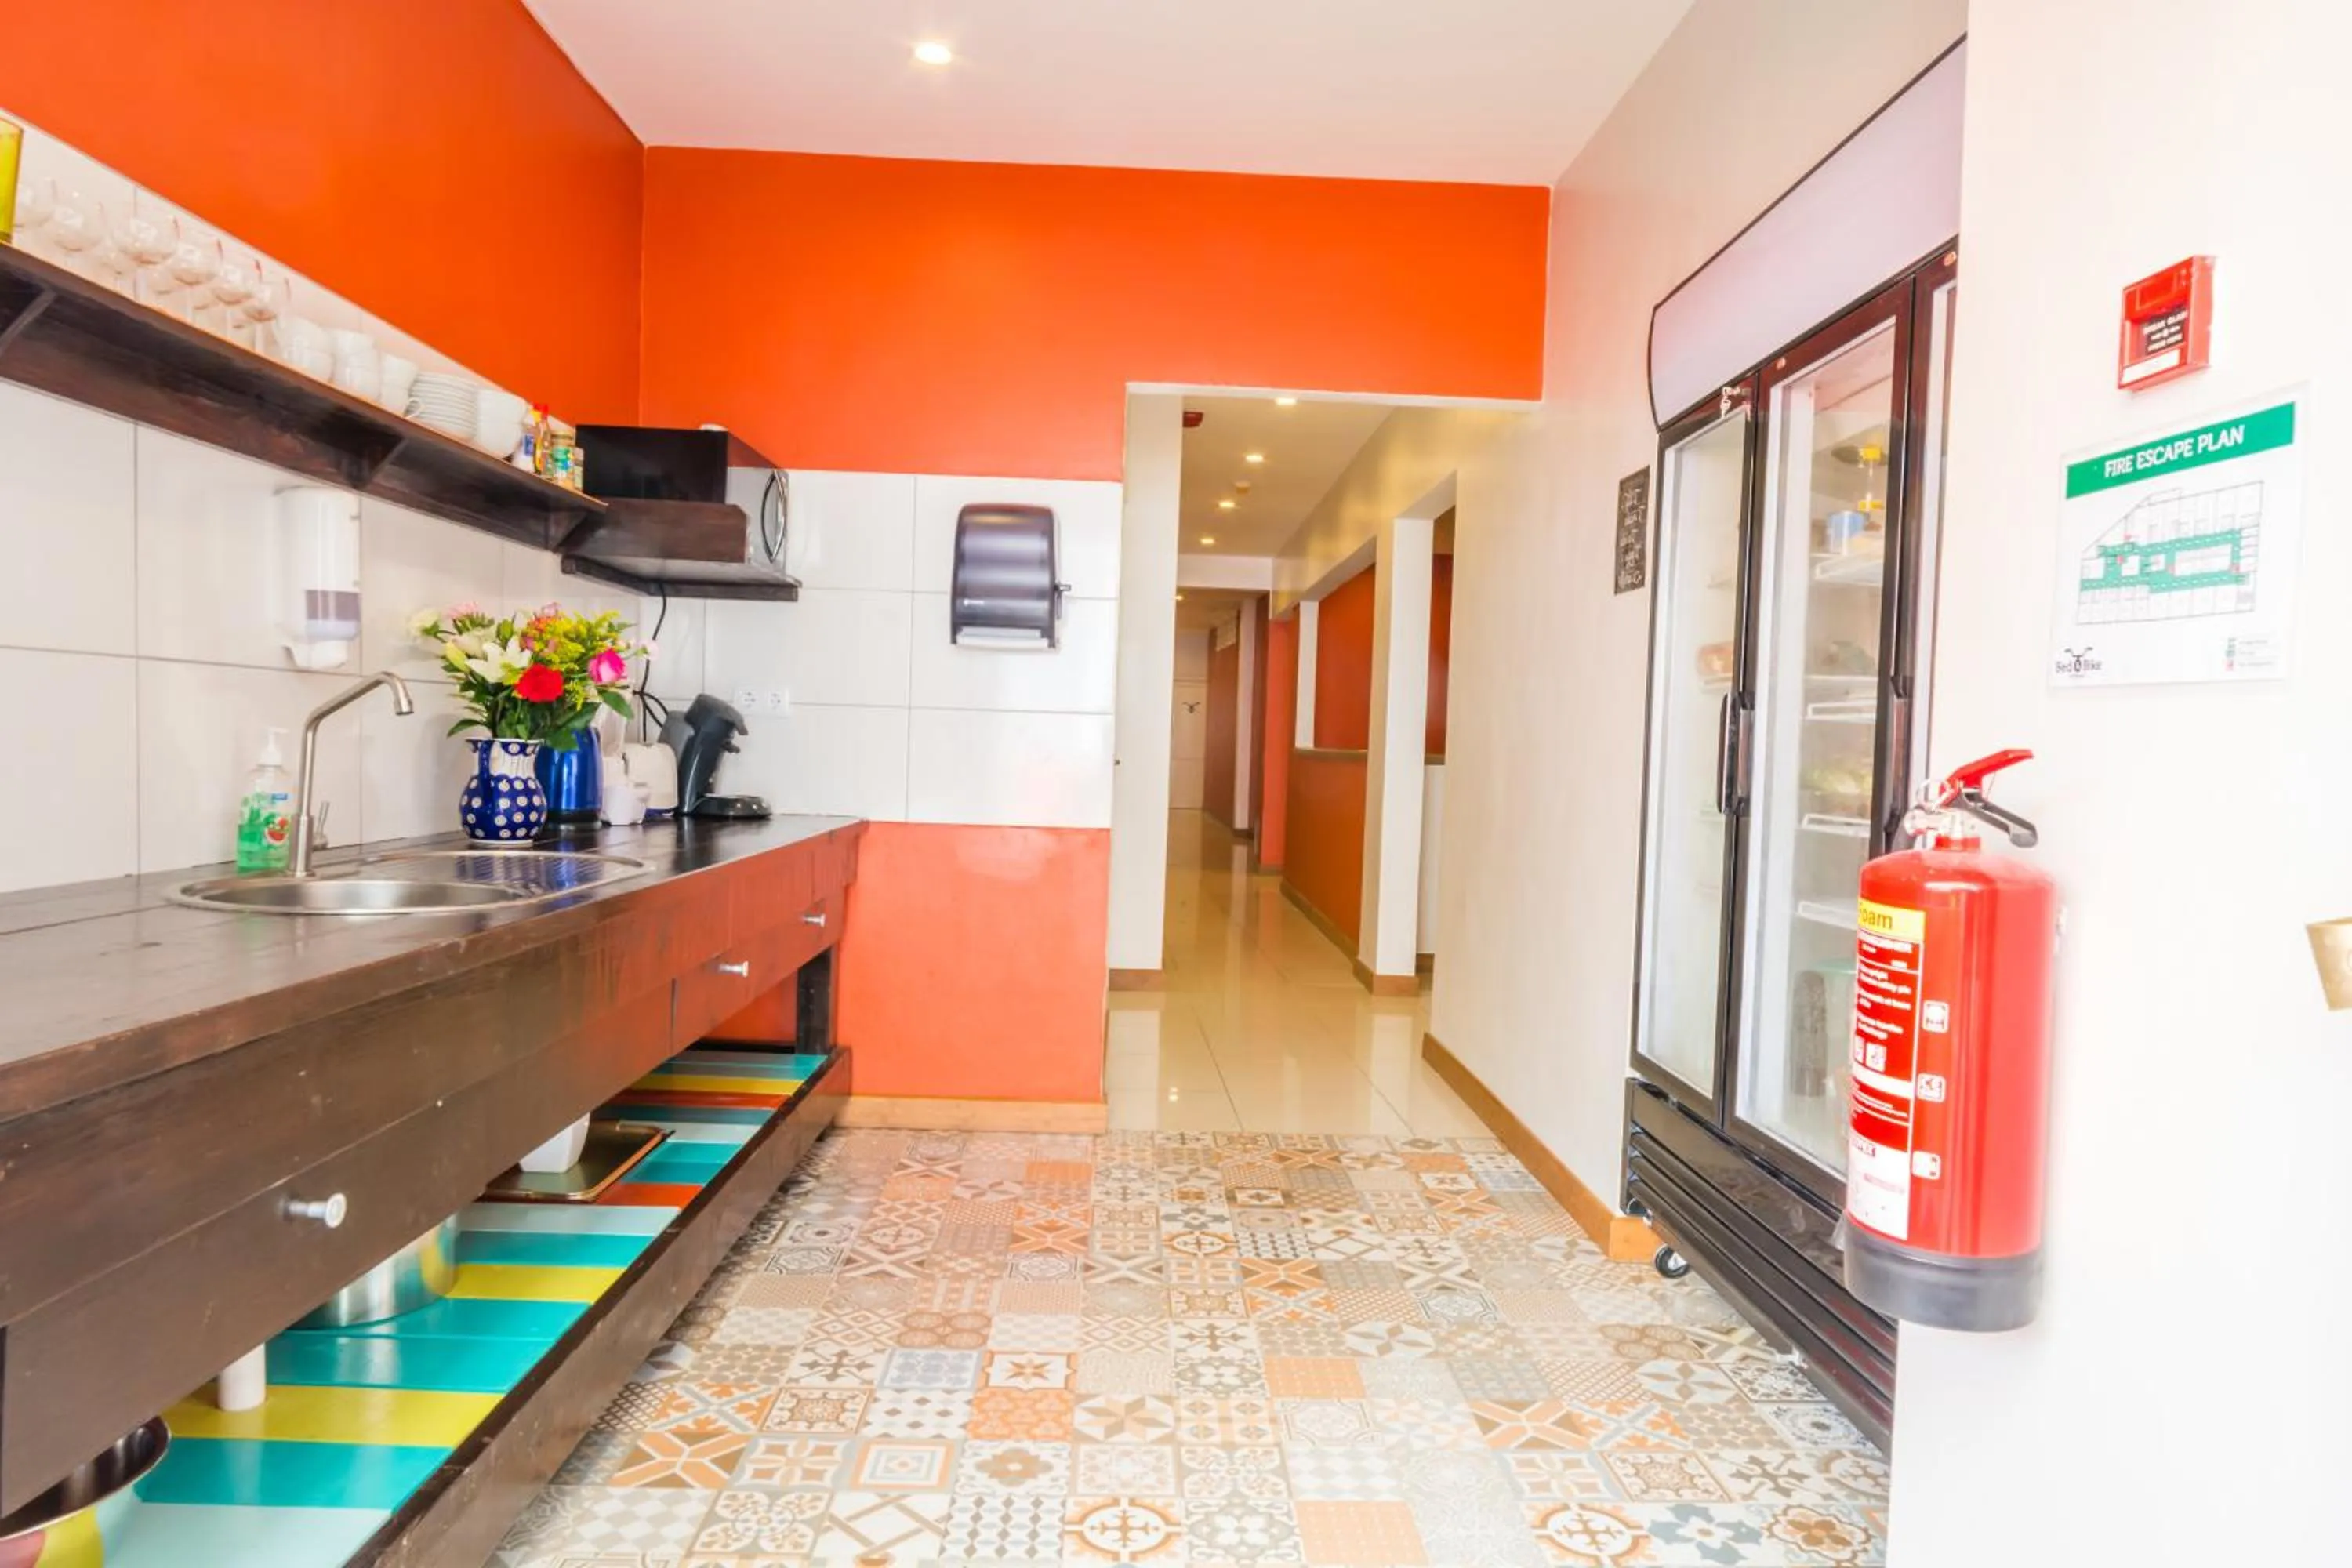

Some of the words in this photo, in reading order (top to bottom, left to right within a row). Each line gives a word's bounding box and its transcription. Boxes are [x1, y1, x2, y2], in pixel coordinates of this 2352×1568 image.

[2104, 454, 2134, 477] FIRE
[2136, 437, 2194, 470] ESCAPE
[2197, 424, 2245, 453] PLAN
